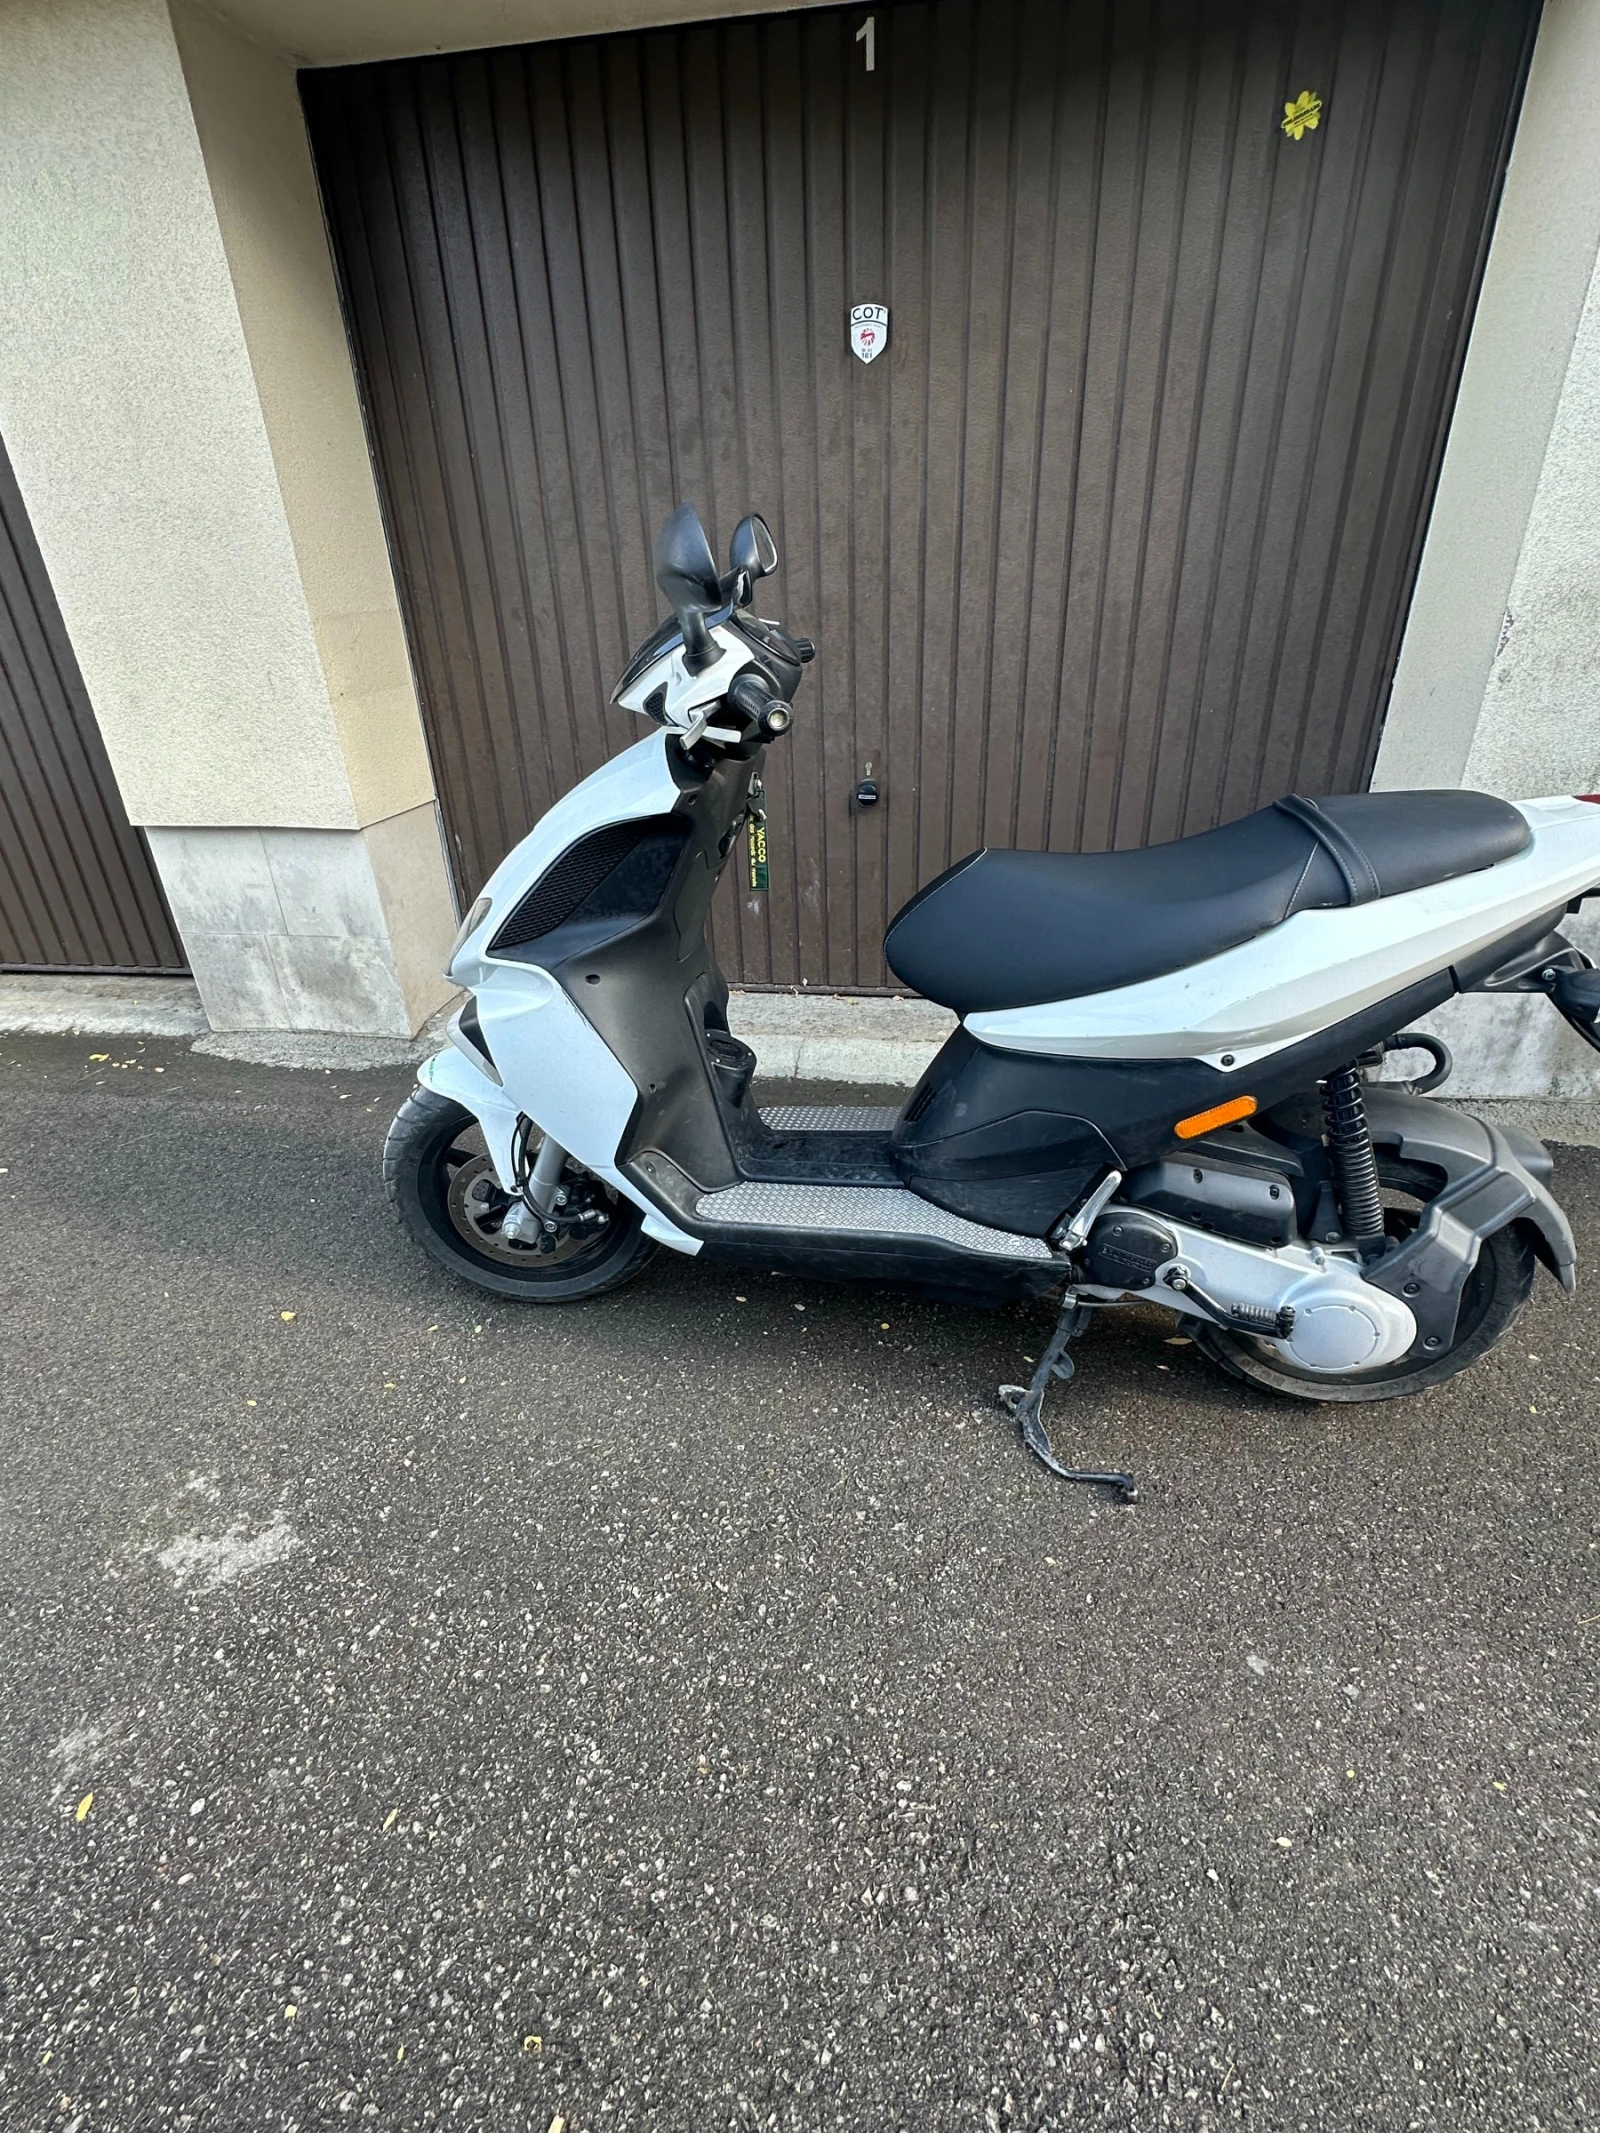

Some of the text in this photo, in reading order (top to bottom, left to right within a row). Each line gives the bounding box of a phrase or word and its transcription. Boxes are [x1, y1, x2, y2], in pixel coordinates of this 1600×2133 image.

[856, 16, 875, 71] 1
[852, 306, 884, 320] COT
[757, 826, 767, 863] YACCO
